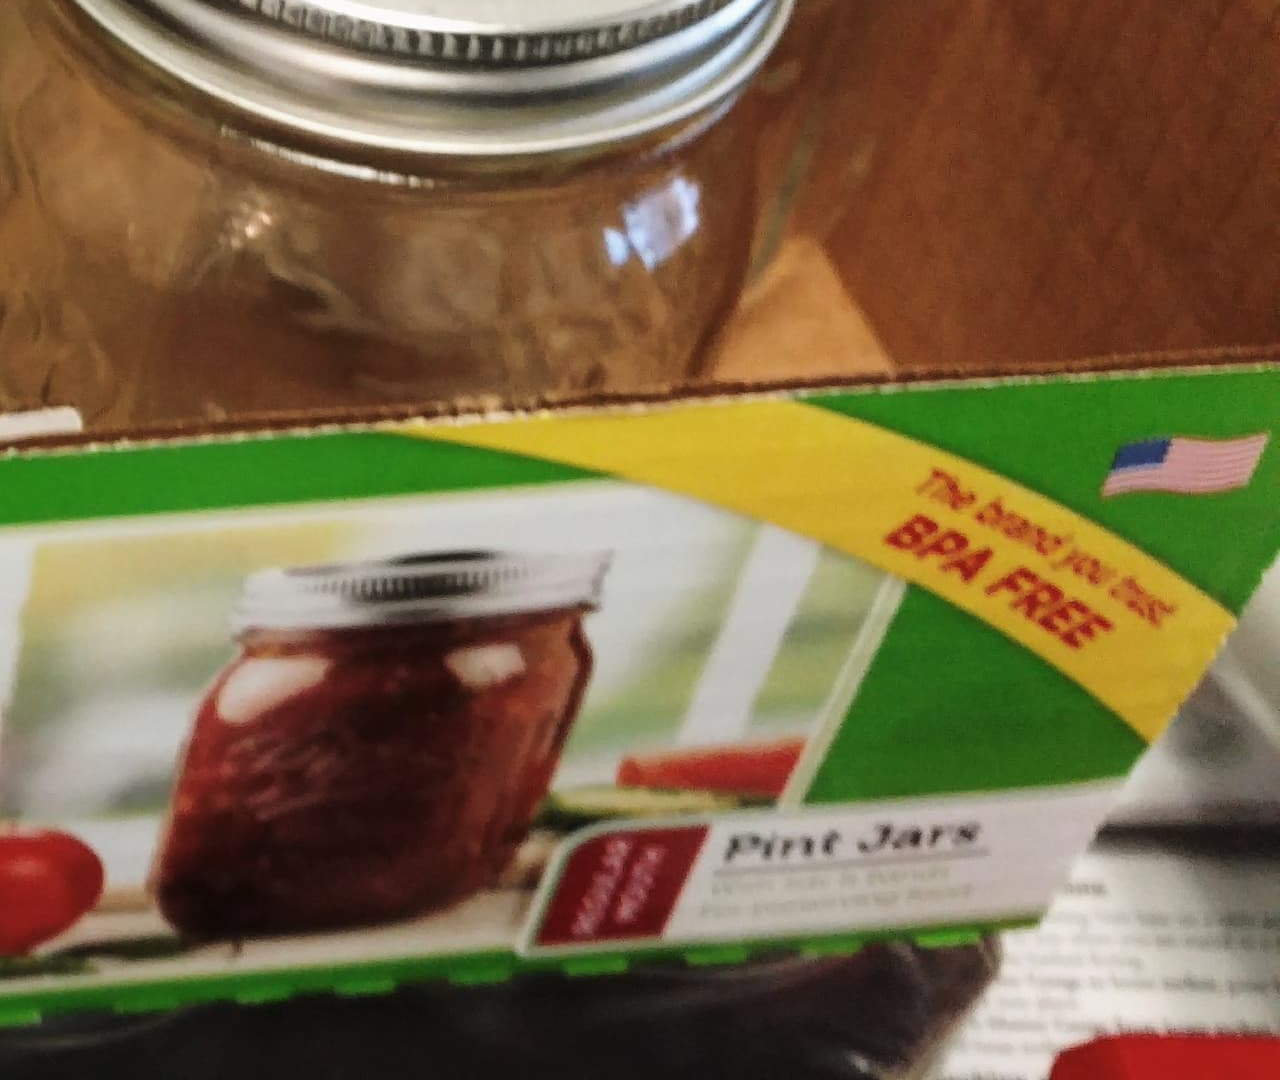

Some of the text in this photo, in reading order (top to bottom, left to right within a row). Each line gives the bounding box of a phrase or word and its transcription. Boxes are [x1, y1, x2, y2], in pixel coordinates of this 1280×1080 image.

[916, 467, 976, 510] The
[975, 497, 1072, 557] brand
[884, 514, 1116, 650] BPA FREE
[725, 821, 981, 863] Pint Jars
